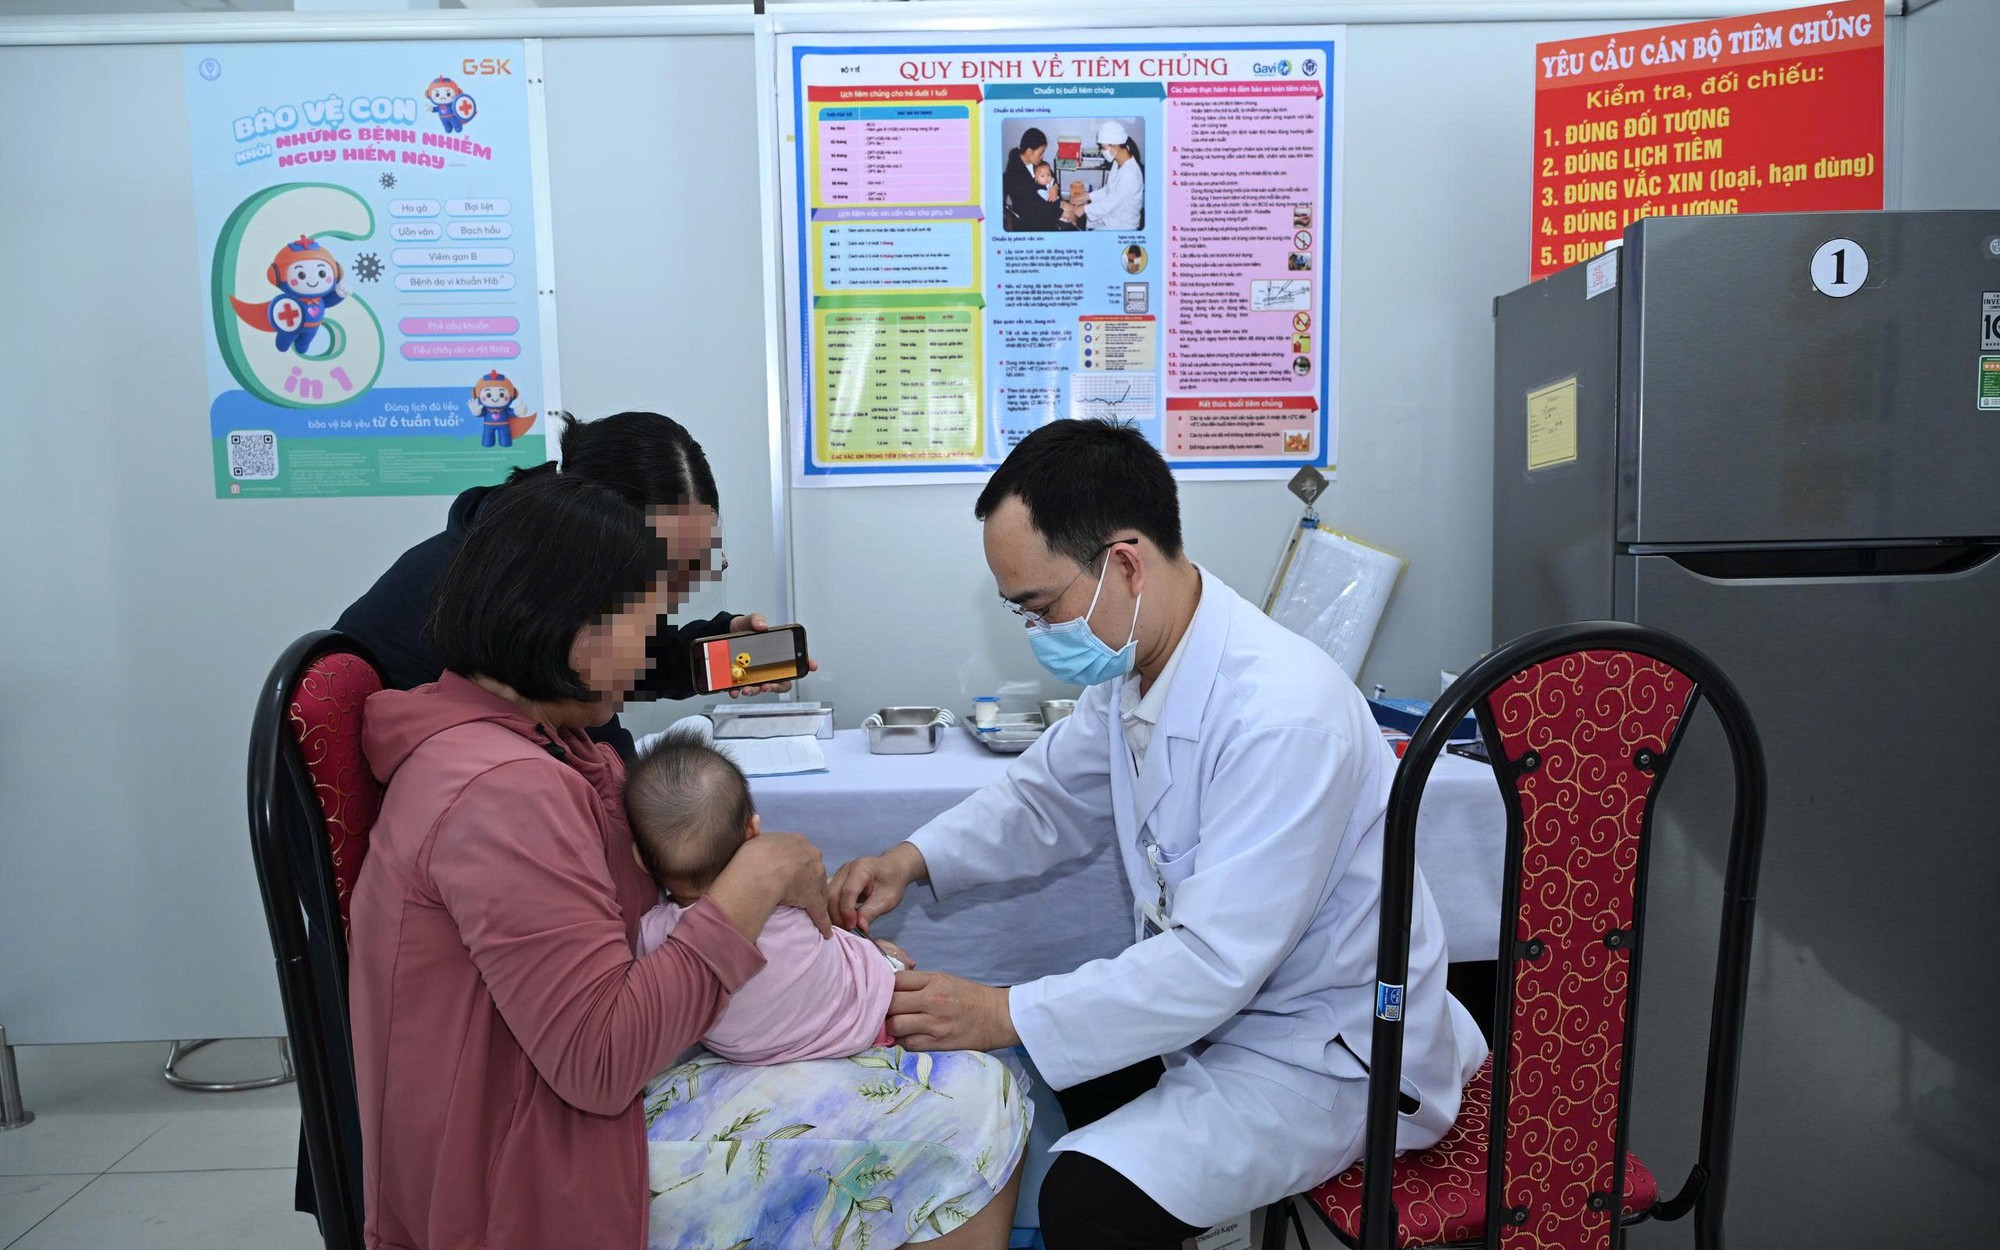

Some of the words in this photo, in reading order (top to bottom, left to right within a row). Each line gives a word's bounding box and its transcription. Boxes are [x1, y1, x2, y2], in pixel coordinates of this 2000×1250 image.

[1542, 48, 1584, 78] YÊU
[1590, 38, 1635, 73] CẦU
[1640, 35, 1687, 66] CÁN
[1692, 28, 1723, 63] BỘ
[1728, 22, 1783, 55] TIÊM
[1789, 9, 1873, 47] CHỦNG
[462, 58, 512, 75] GSK
[899, 61, 952, 81] QUY
[961, 60, 1022, 82] ĐỊNH
[1032, 53, 1064, 78] VỀ
[1071, 56, 1130, 78] TIÊM
[1139, 53, 1229, 77] CHỦNG
[1252, 61, 1277, 75] Gavi
[1586, 82, 1645, 110] Kiểm
[1654, 84, 1693, 101] tra,
[1701, 71, 1739, 96] đối
[1747, 62, 1825, 90] chiếu:
[233, 106, 299, 143] BẢO
[302, 93, 344, 129] VỆ
[350, 97, 417, 125] CON
[1543, 128, 1560, 147] 1.
[1565, 119, 1619, 146] ĐÚNG
[1624, 109, 1657, 138] ĐỐI
[1663, 107, 1730, 135] TƯỢNG
[235, 143, 273, 166] KHỎI
[276, 128, 352, 149] NHỮNG
[358, 126, 416, 144] BỆNH
[422, 131, 492, 160] NHIỄM
[278, 149, 336, 168] NGUY
[343, 144, 396, 162] HIỂM
[402, 151, 445, 170] NÀY
[1541, 157, 1559, 177] 2.
[1565, 149, 1618, 175] ĐÚNG
[1624, 146, 1668, 172] LỊCH
[1674, 137, 1722, 163] TIÊM
[1541, 187, 1558, 207] 3.
[1564, 179, 1617, 204] ĐÚNG
[1623, 169, 1662, 199] VẮC
[1667, 171, 1703, 194] XIN
[1710, 165, 1762, 192] (loại,
[1769, 163, 1807, 187] hạn
[1814, 153, 1874, 180] dùng)
[1541, 217, 1558, 236] 4.
[1563, 208, 1616, 235] ĐÚNG
[1540, 246, 1557, 266] 5.
[1563, 239, 1605, 264] ĐÚN
[1830, 248, 1848, 285] 1
[284, 366, 323, 399] in
[329, 366, 353, 392] 1
[308, 420, 326, 429] bảo
[328, 420, 339, 430] vệ
[340, 420, 353, 428] bé
[354, 420, 370, 430] yêu
[372, 415, 387, 428] từ
[389, 417, 398, 427] 6
[401, 414, 431, 427] tuần
[434, 412, 459, 427] tuổi
[384, 402, 410, 414] Đúng
[411, 402, 428, 413] lịch
[429, 402, 442, 411] đủ
